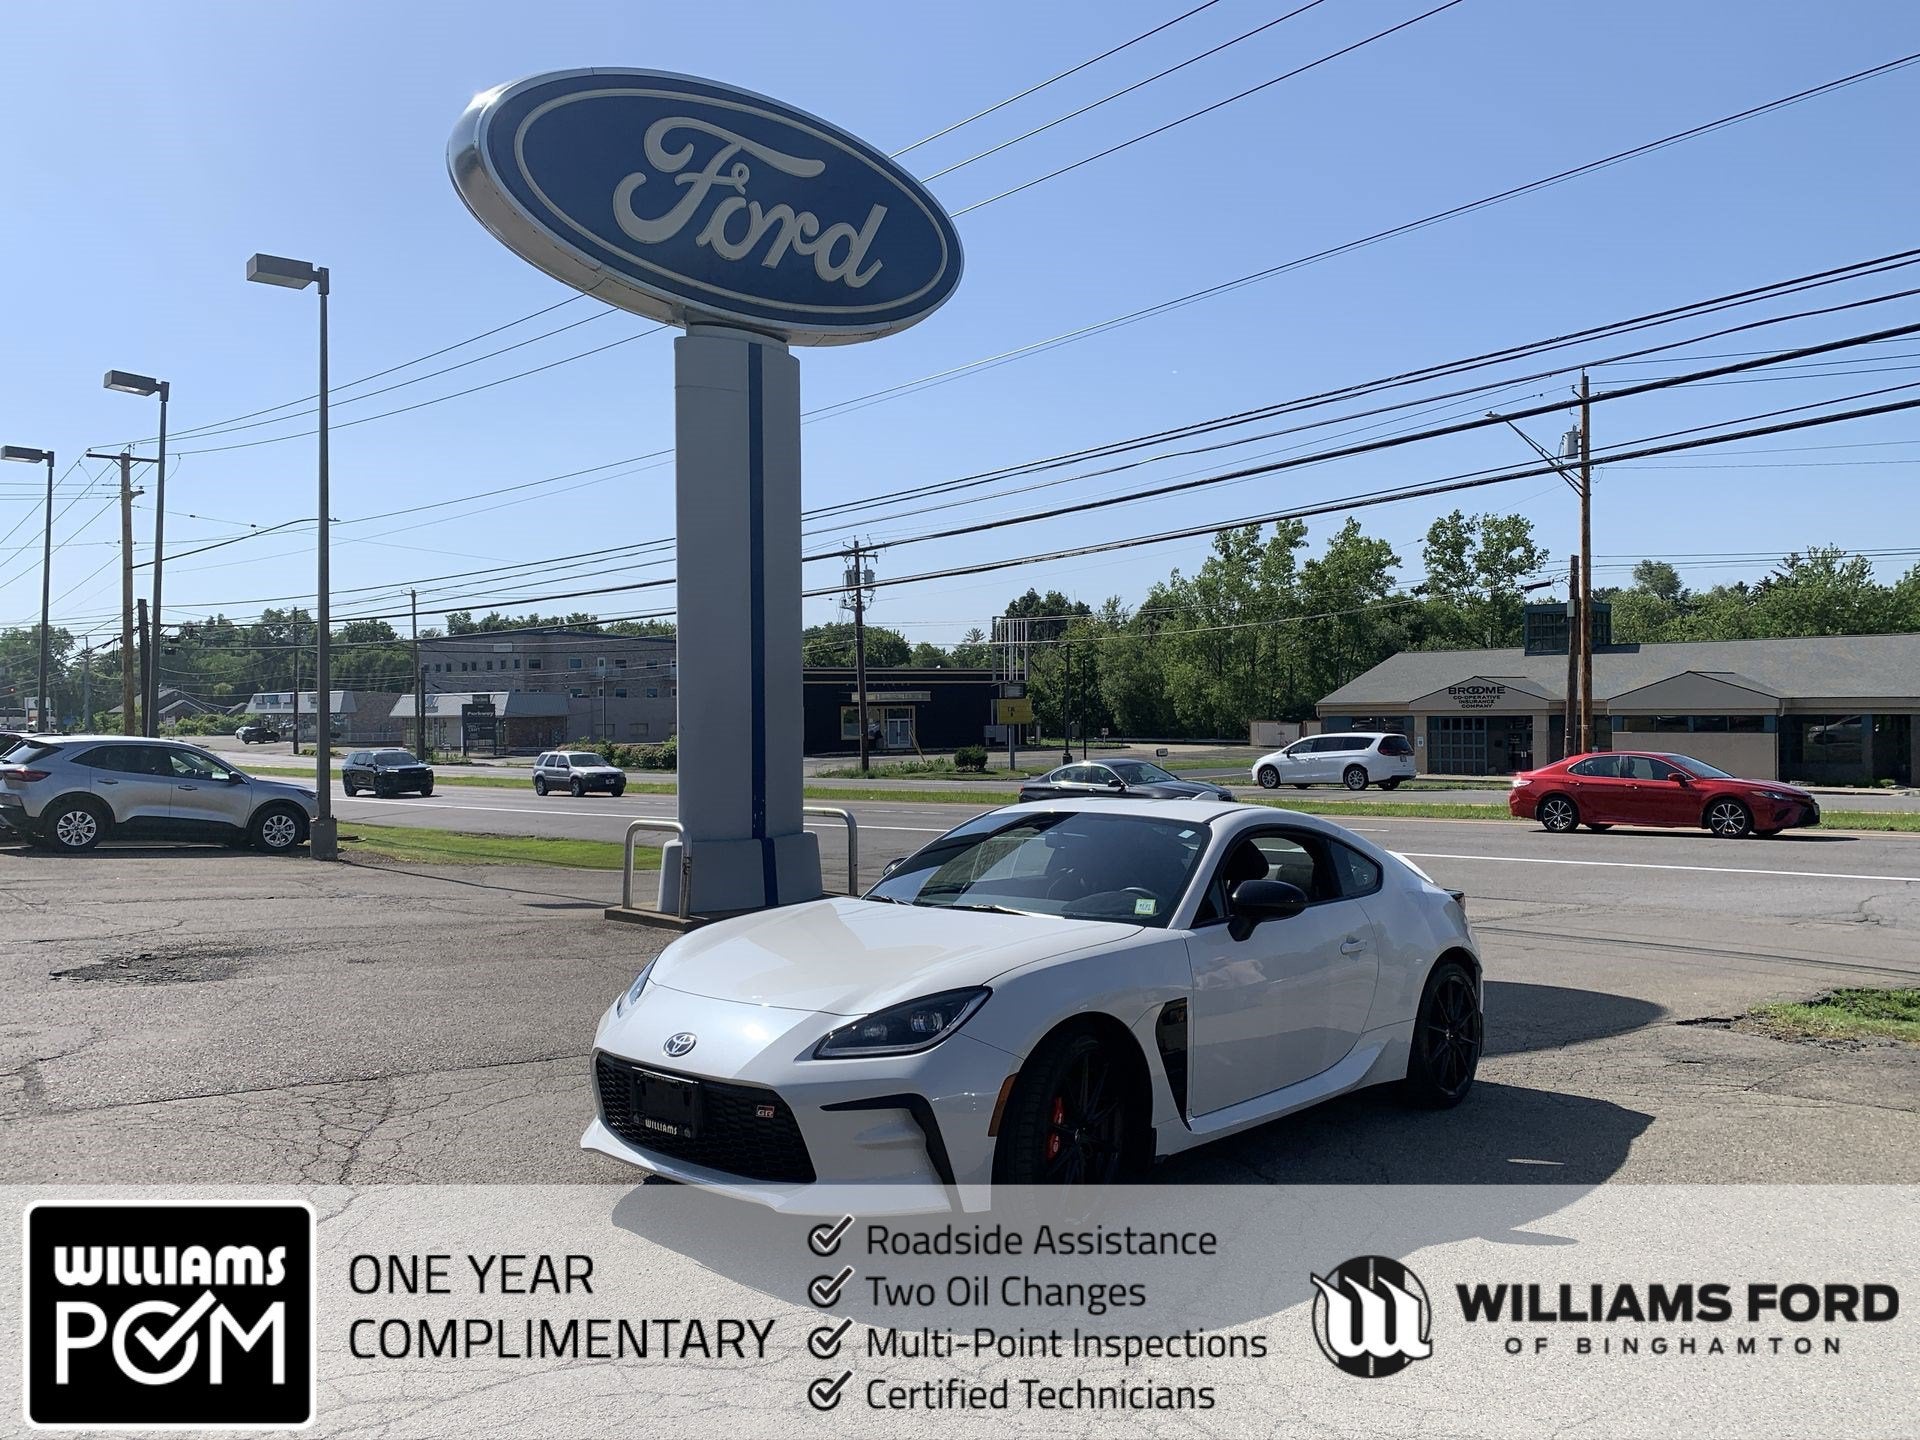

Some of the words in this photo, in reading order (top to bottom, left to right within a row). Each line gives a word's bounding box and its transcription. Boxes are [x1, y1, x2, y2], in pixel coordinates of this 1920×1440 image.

[612, 116, 888, 288] Ford
[1448, 686, 1506, 695] BROOME
[644, 1118, 678, 1136] WILLIAMS
